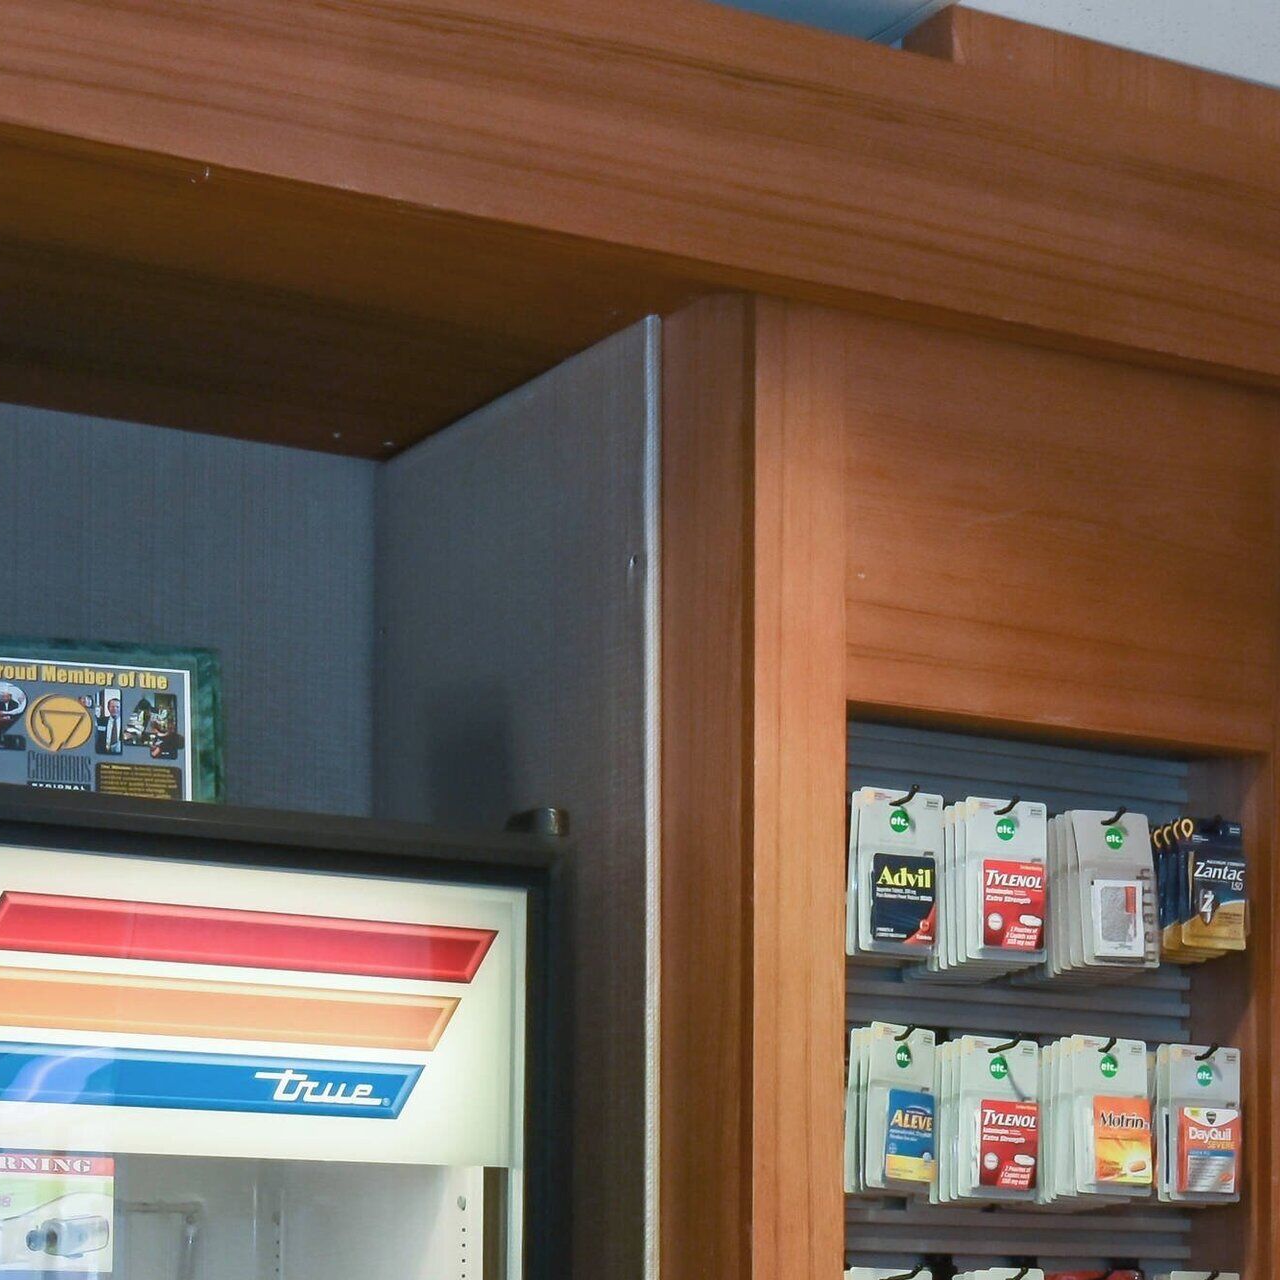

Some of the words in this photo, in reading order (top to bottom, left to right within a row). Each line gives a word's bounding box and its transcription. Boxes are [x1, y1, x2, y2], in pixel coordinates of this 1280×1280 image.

[42, 664, 114, 686] Member
[119, 671, 136, 687] of
[139, 671, 168, 690] the
[876, 866, 932, 888] Advil
[985, 870, 1042, 889] TYLENOL
[1194, 861, 1245, 881] Zantac
[1004, 897, 1032, 905] Strength
[254, 1069, 383, 1106] true
[890, 1109, 933, 1131] ALEVE
[982, 1109, 1036, 1128] TYLENOL
[1099, 1111, 1144, 1129] Motrin
[1188, 1127, 1232, 1143] DayQuil
